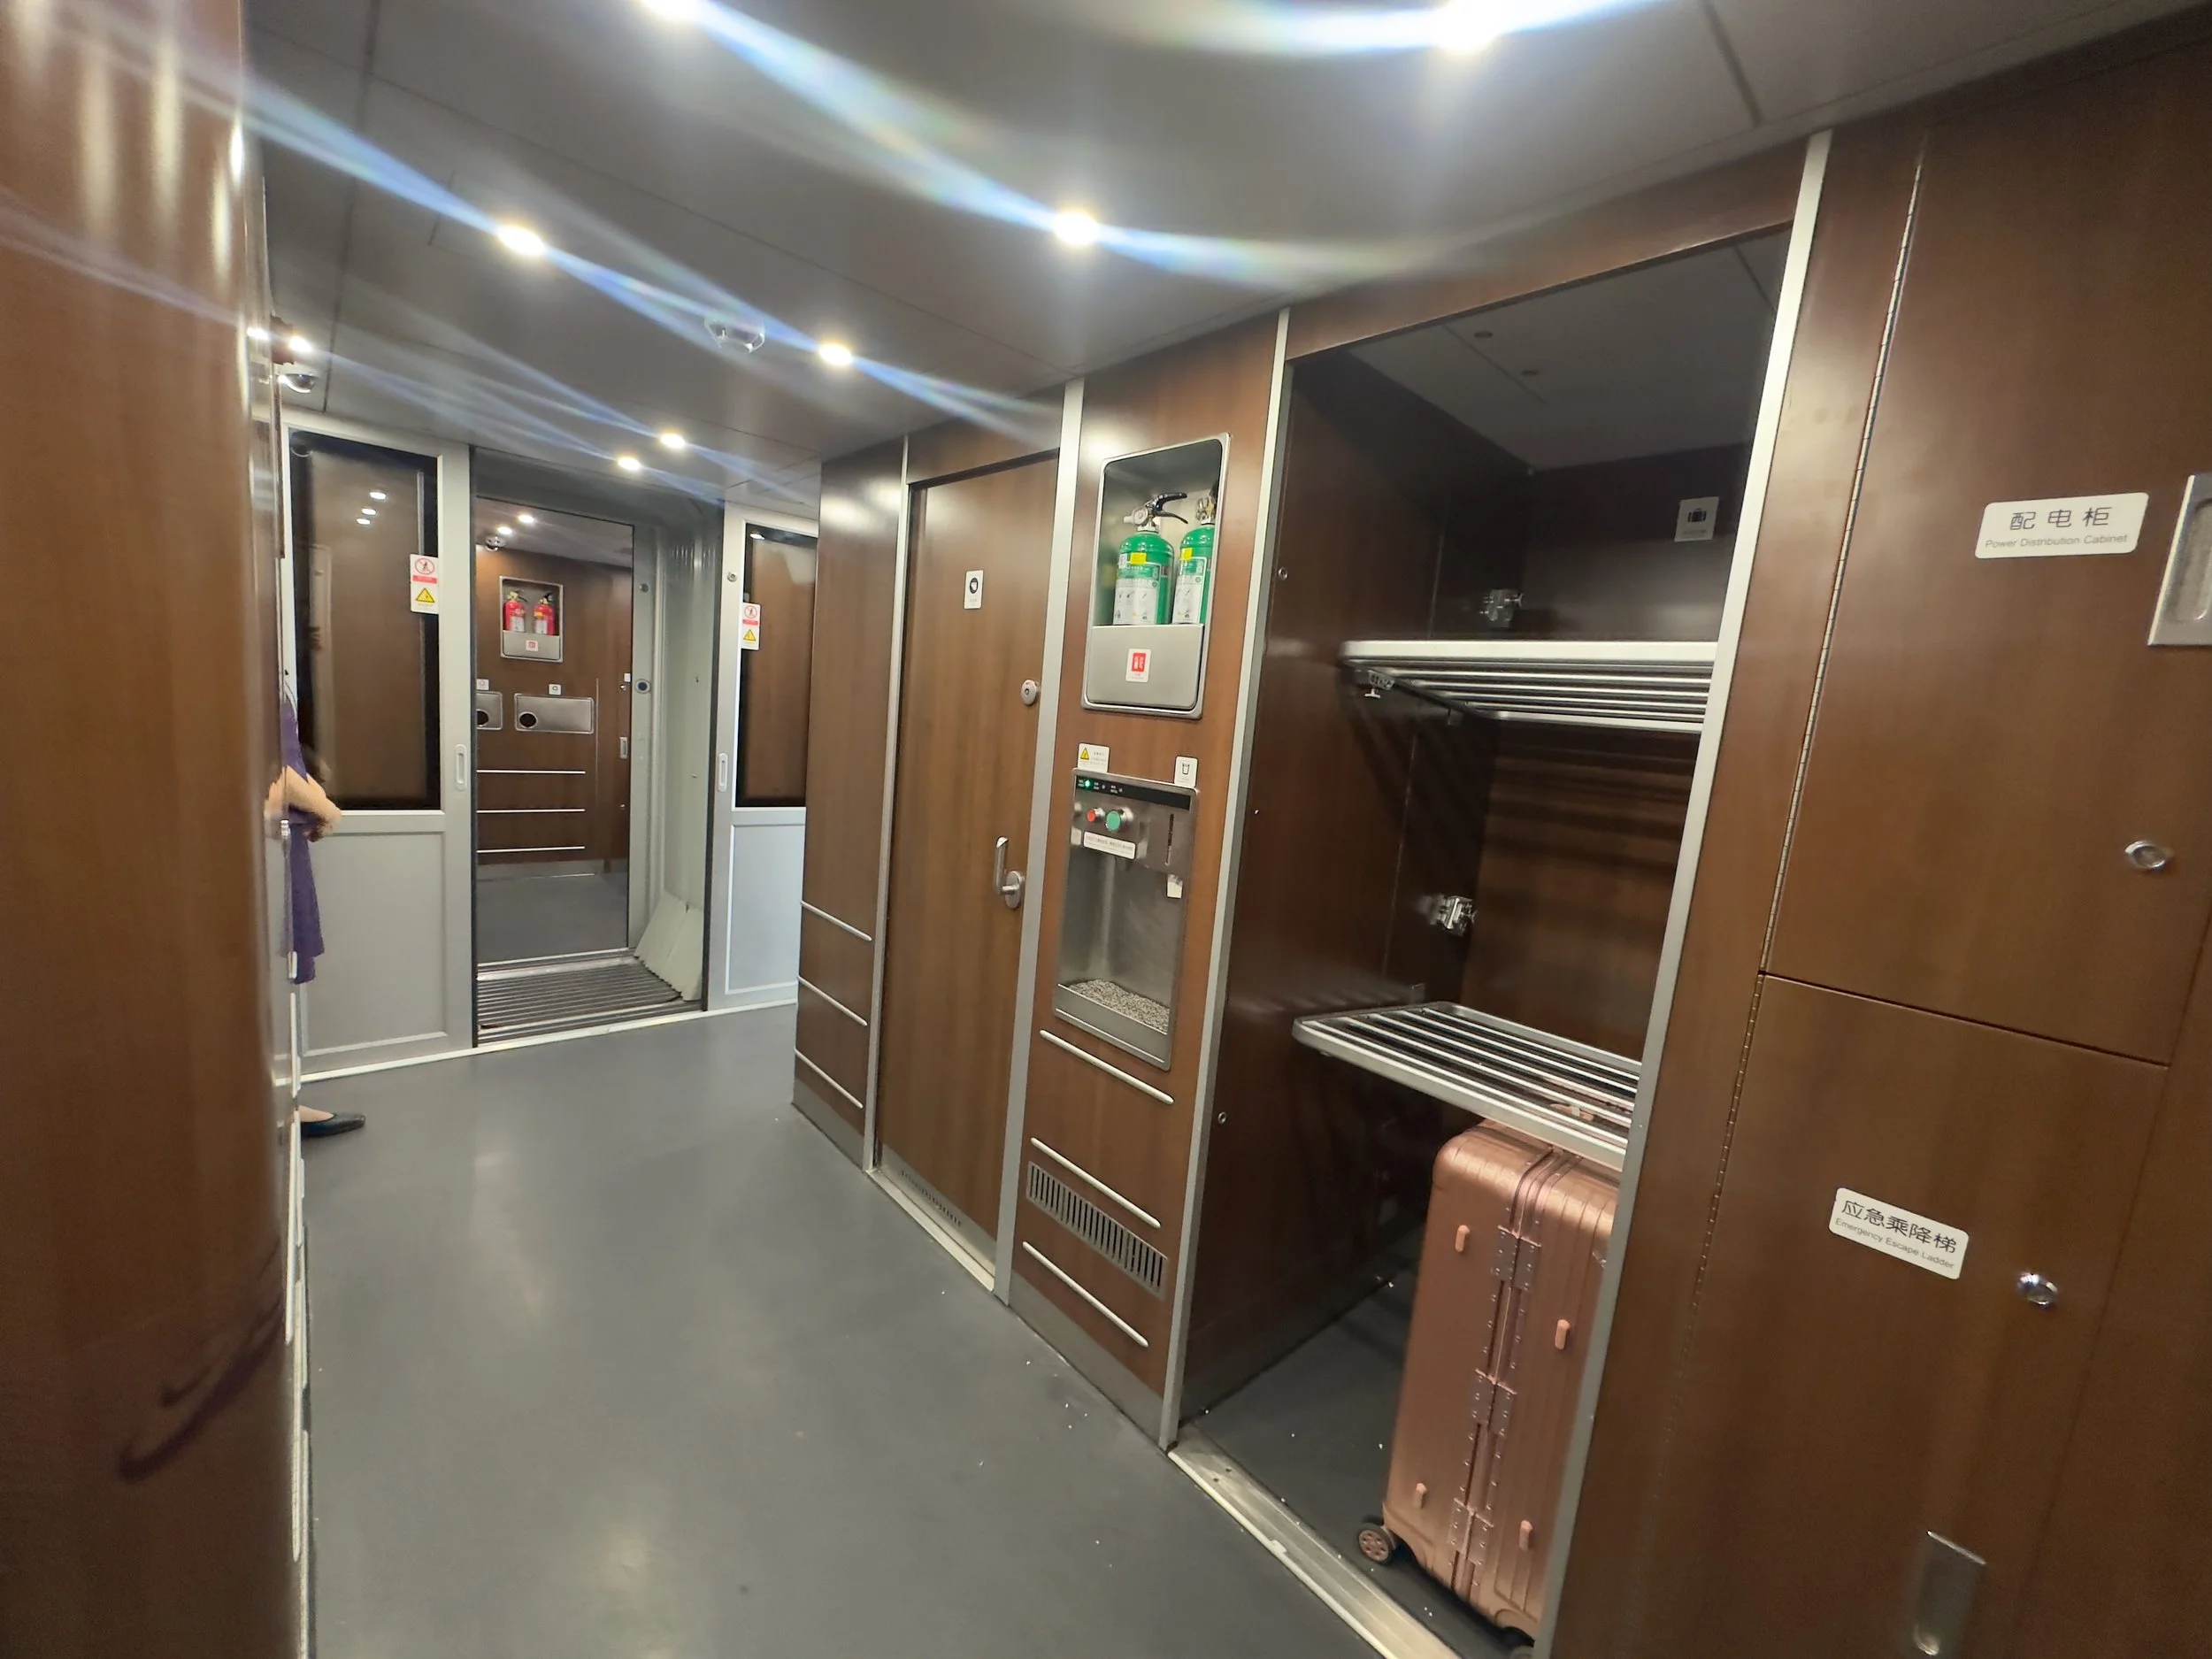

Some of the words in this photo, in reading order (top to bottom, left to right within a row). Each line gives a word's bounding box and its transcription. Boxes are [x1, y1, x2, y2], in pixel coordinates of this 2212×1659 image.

[2009, 507, 2113, 531] 配电柜
[1985, 540, 2017, 549] Power
[2020, 536, 2080, 547] Distribution
[2084, 534, 2128, 544] Cabinet
[1835, 1217, 1883, 1242] Emergency
[1886, 1237, 1919, 1256] Escape
[1922, 1251, 1955, 1269] Ladder
[1841, 1200, 1957, 1253] 应急乘降梯
